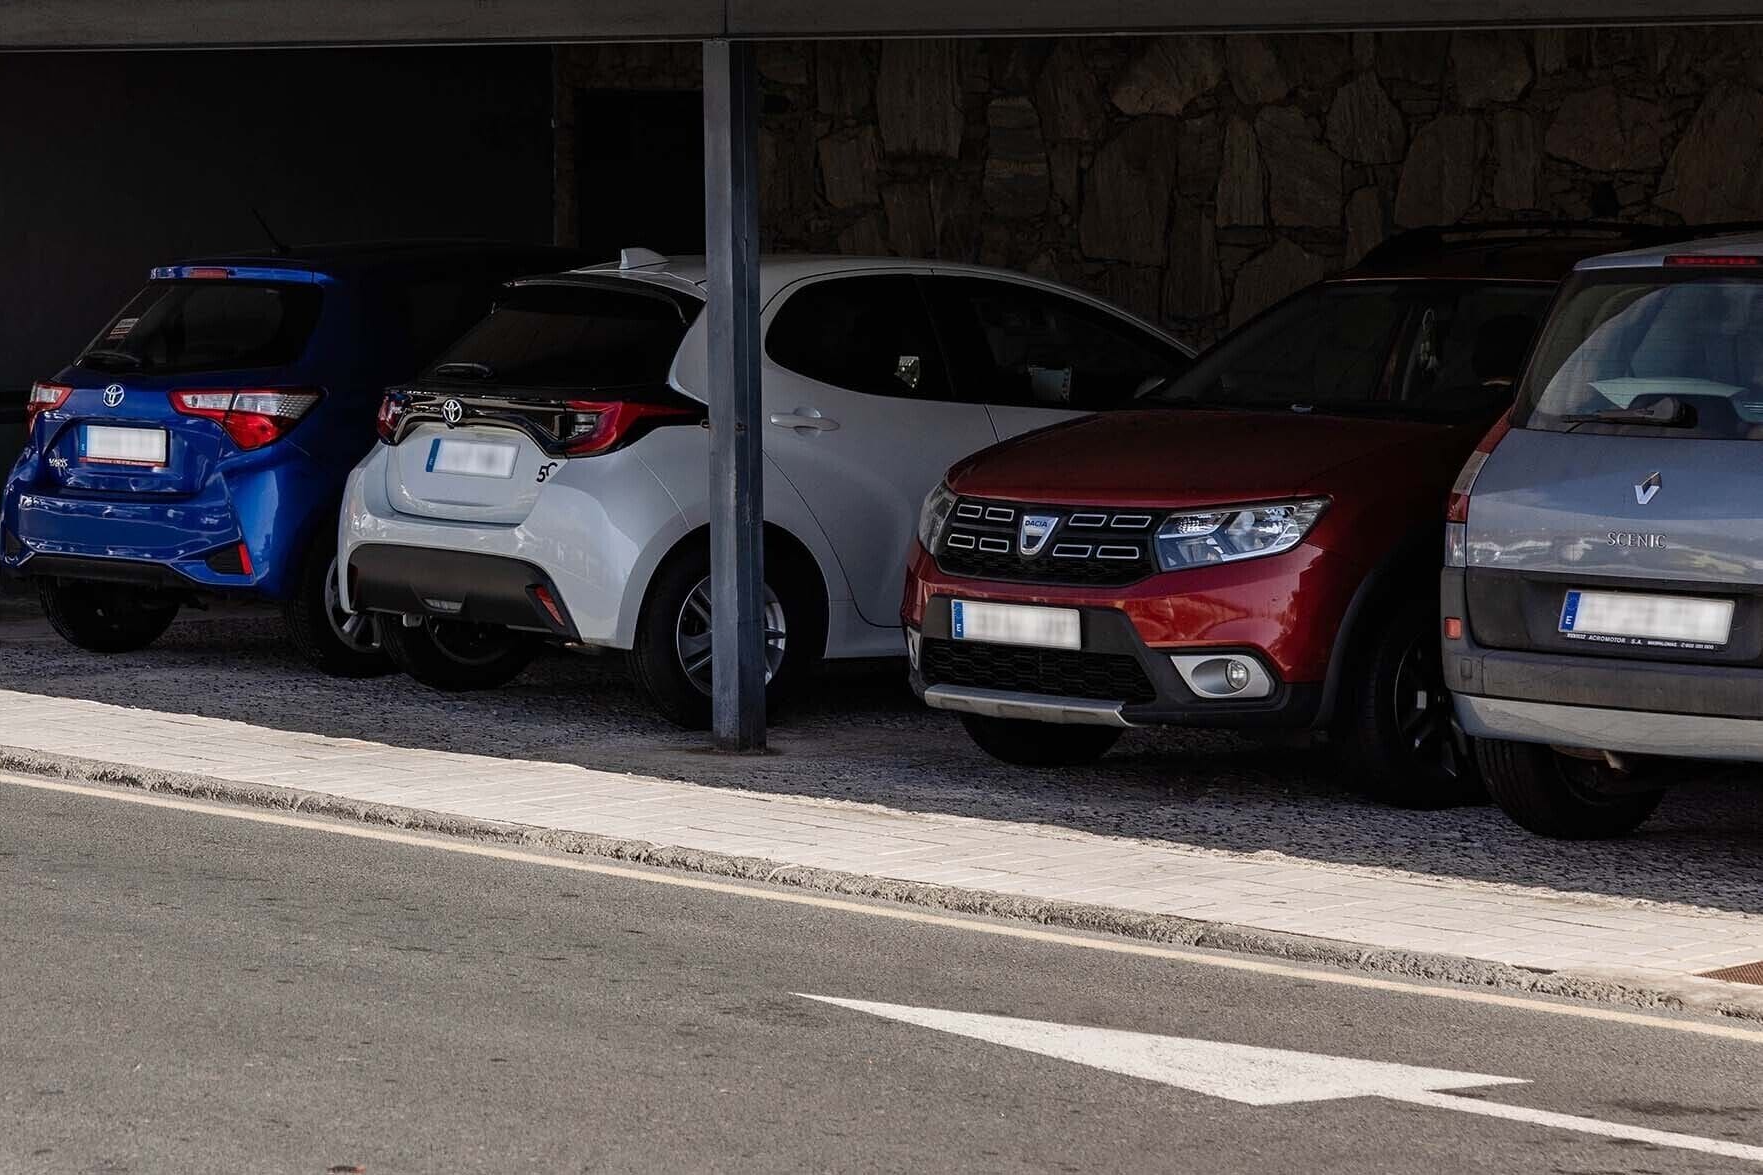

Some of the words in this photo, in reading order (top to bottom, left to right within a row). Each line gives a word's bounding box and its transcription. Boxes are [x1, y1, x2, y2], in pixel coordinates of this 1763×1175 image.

[1606, 531, 1667, 549] SCENIC
[1565, 615, 1573, 624] E
[956, 623, 961, 632] E
